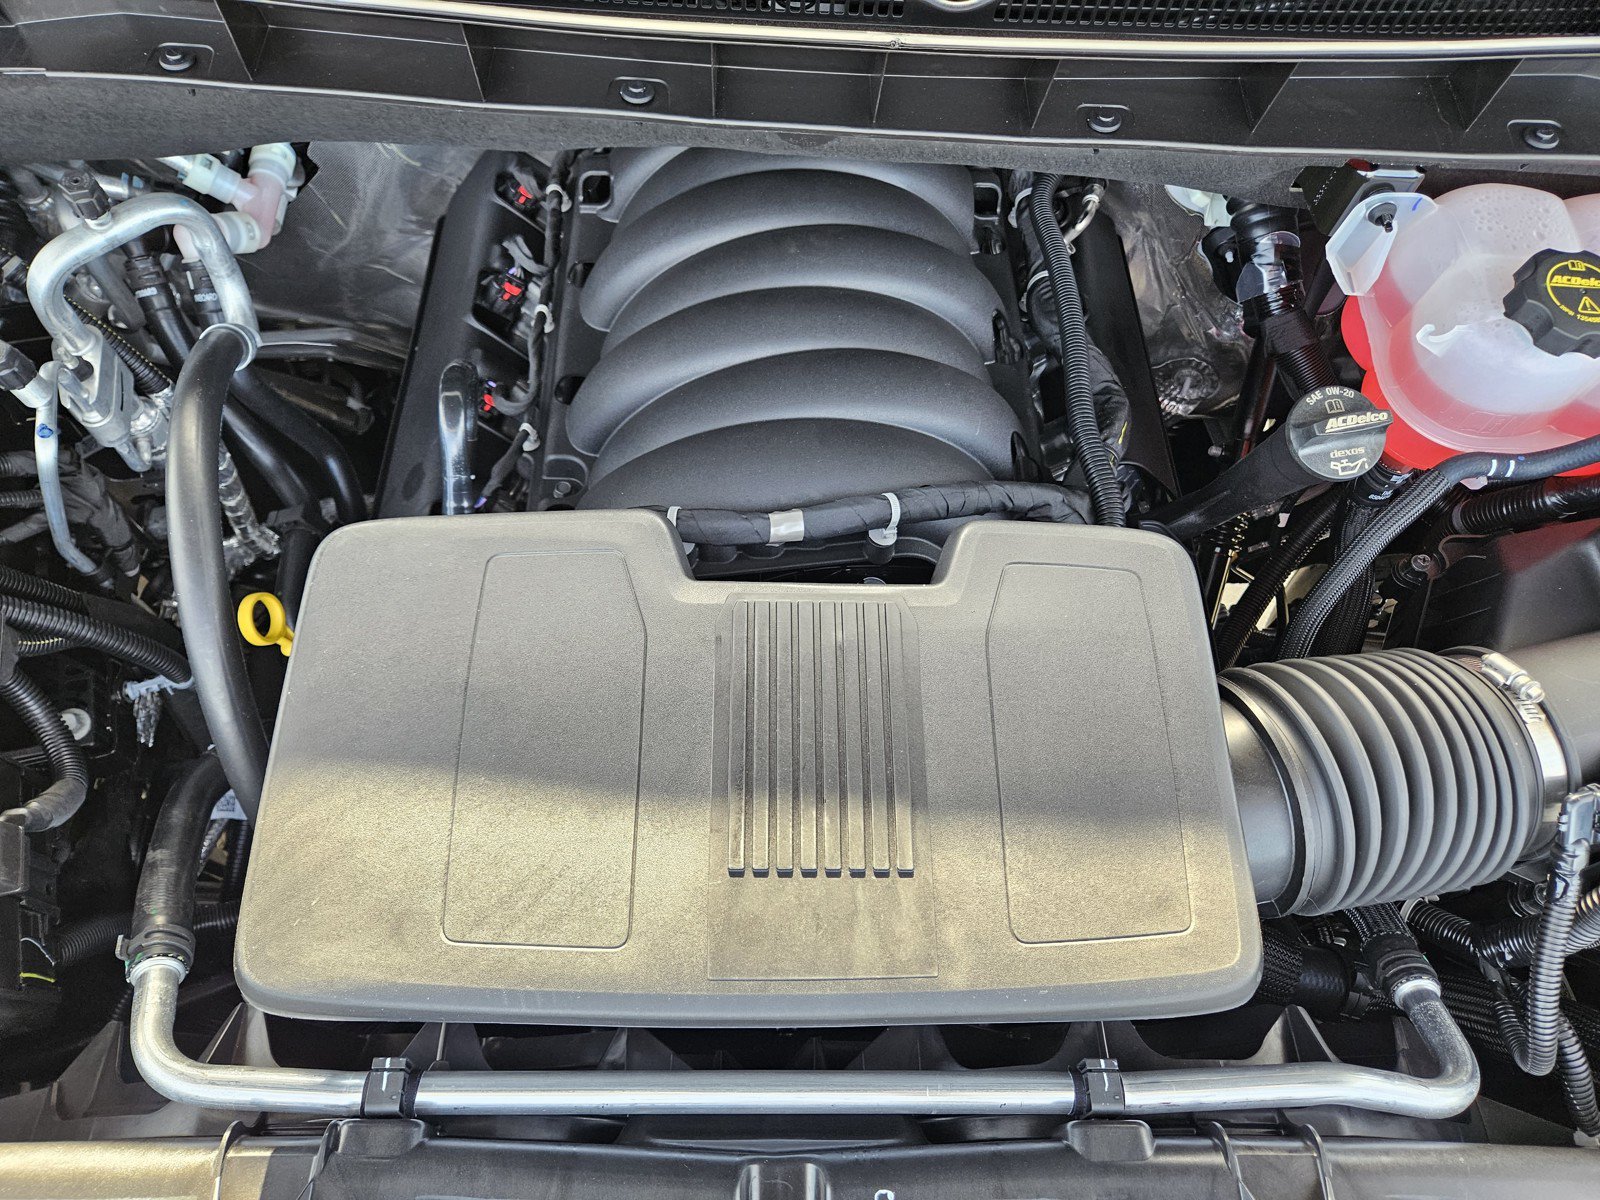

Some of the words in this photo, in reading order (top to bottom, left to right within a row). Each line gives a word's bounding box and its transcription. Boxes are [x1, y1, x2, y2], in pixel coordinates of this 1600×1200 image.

[1551, 275, 1600, 287] ACDelc
[1306, 390, 1324, 406] SAE
[1325, 386, 1355, 398] 0W-20
[1325, 411, 1388, 430] ACDelco
[1329, 446, 1365, 459] dexos
